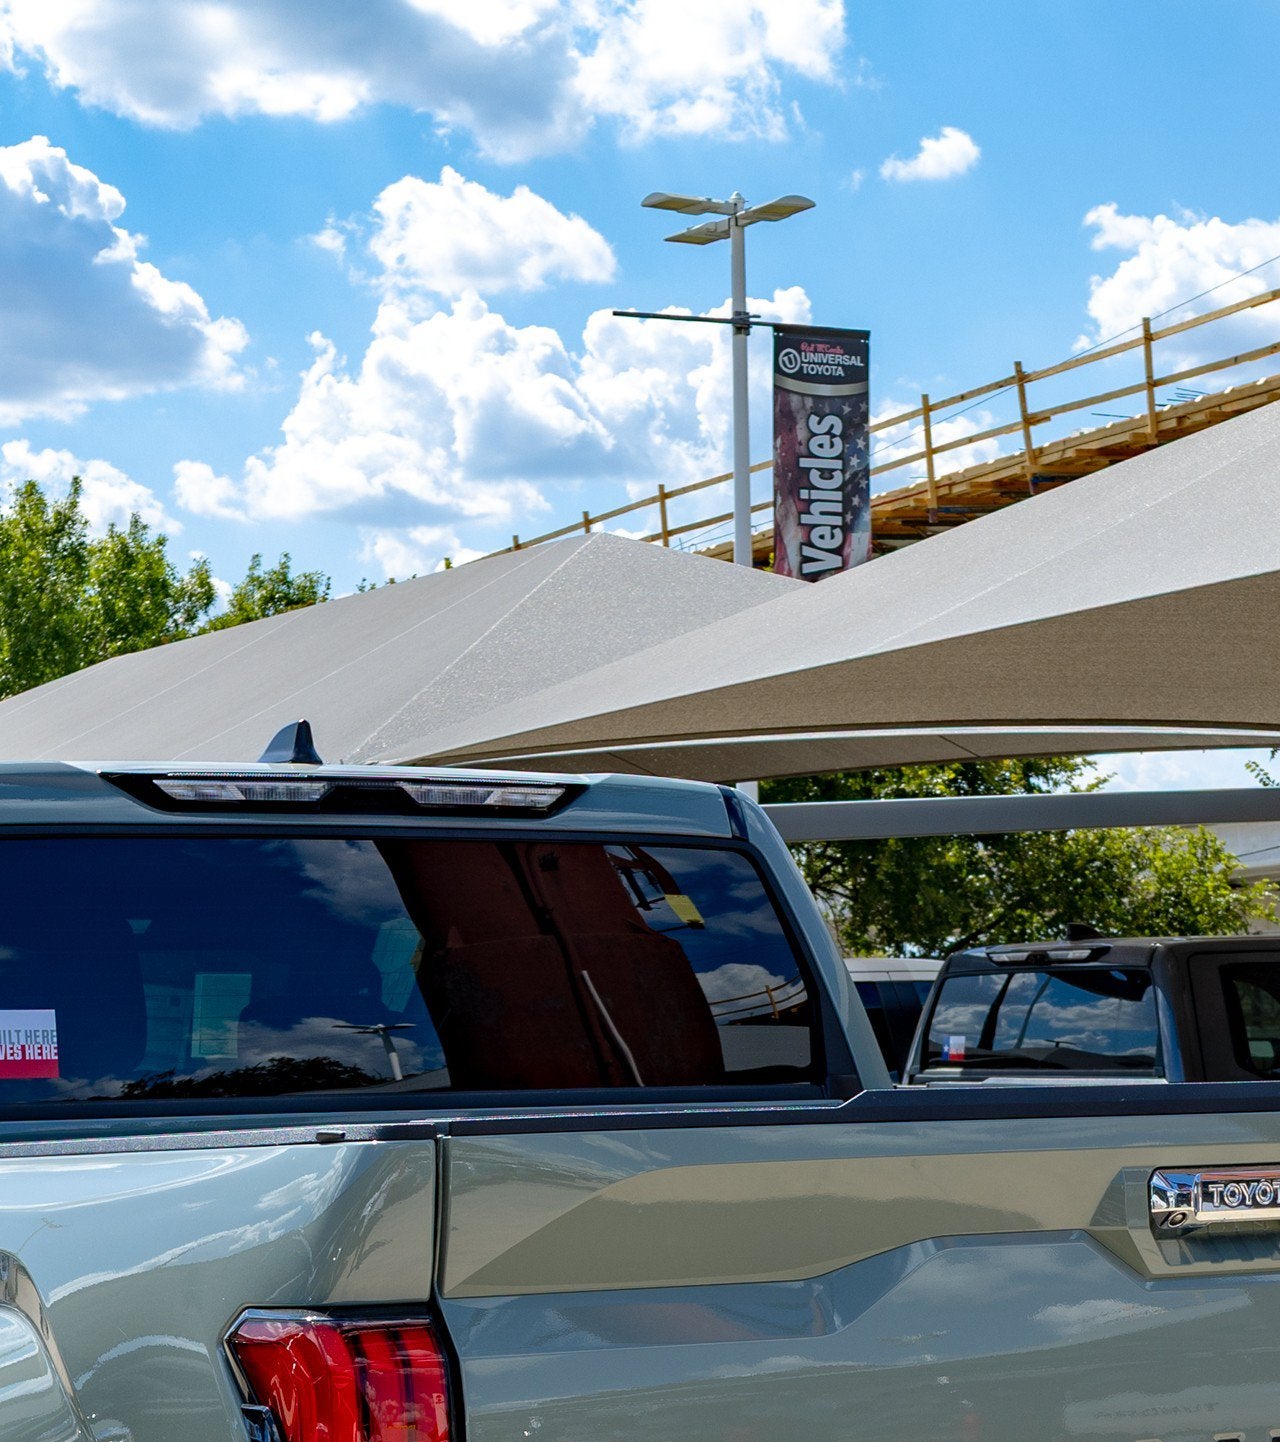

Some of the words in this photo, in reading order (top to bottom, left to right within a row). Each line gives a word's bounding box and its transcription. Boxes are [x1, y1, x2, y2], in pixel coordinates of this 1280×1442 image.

[801, 352, 864, 367] UNIVERSAL
[801, 364, 845, 377] TOYOTA
[799, 413, 844, 575] Vehicles
[24, 1029, 58, 1045] HERE
[25, 1045, 59, 1061] HERE
